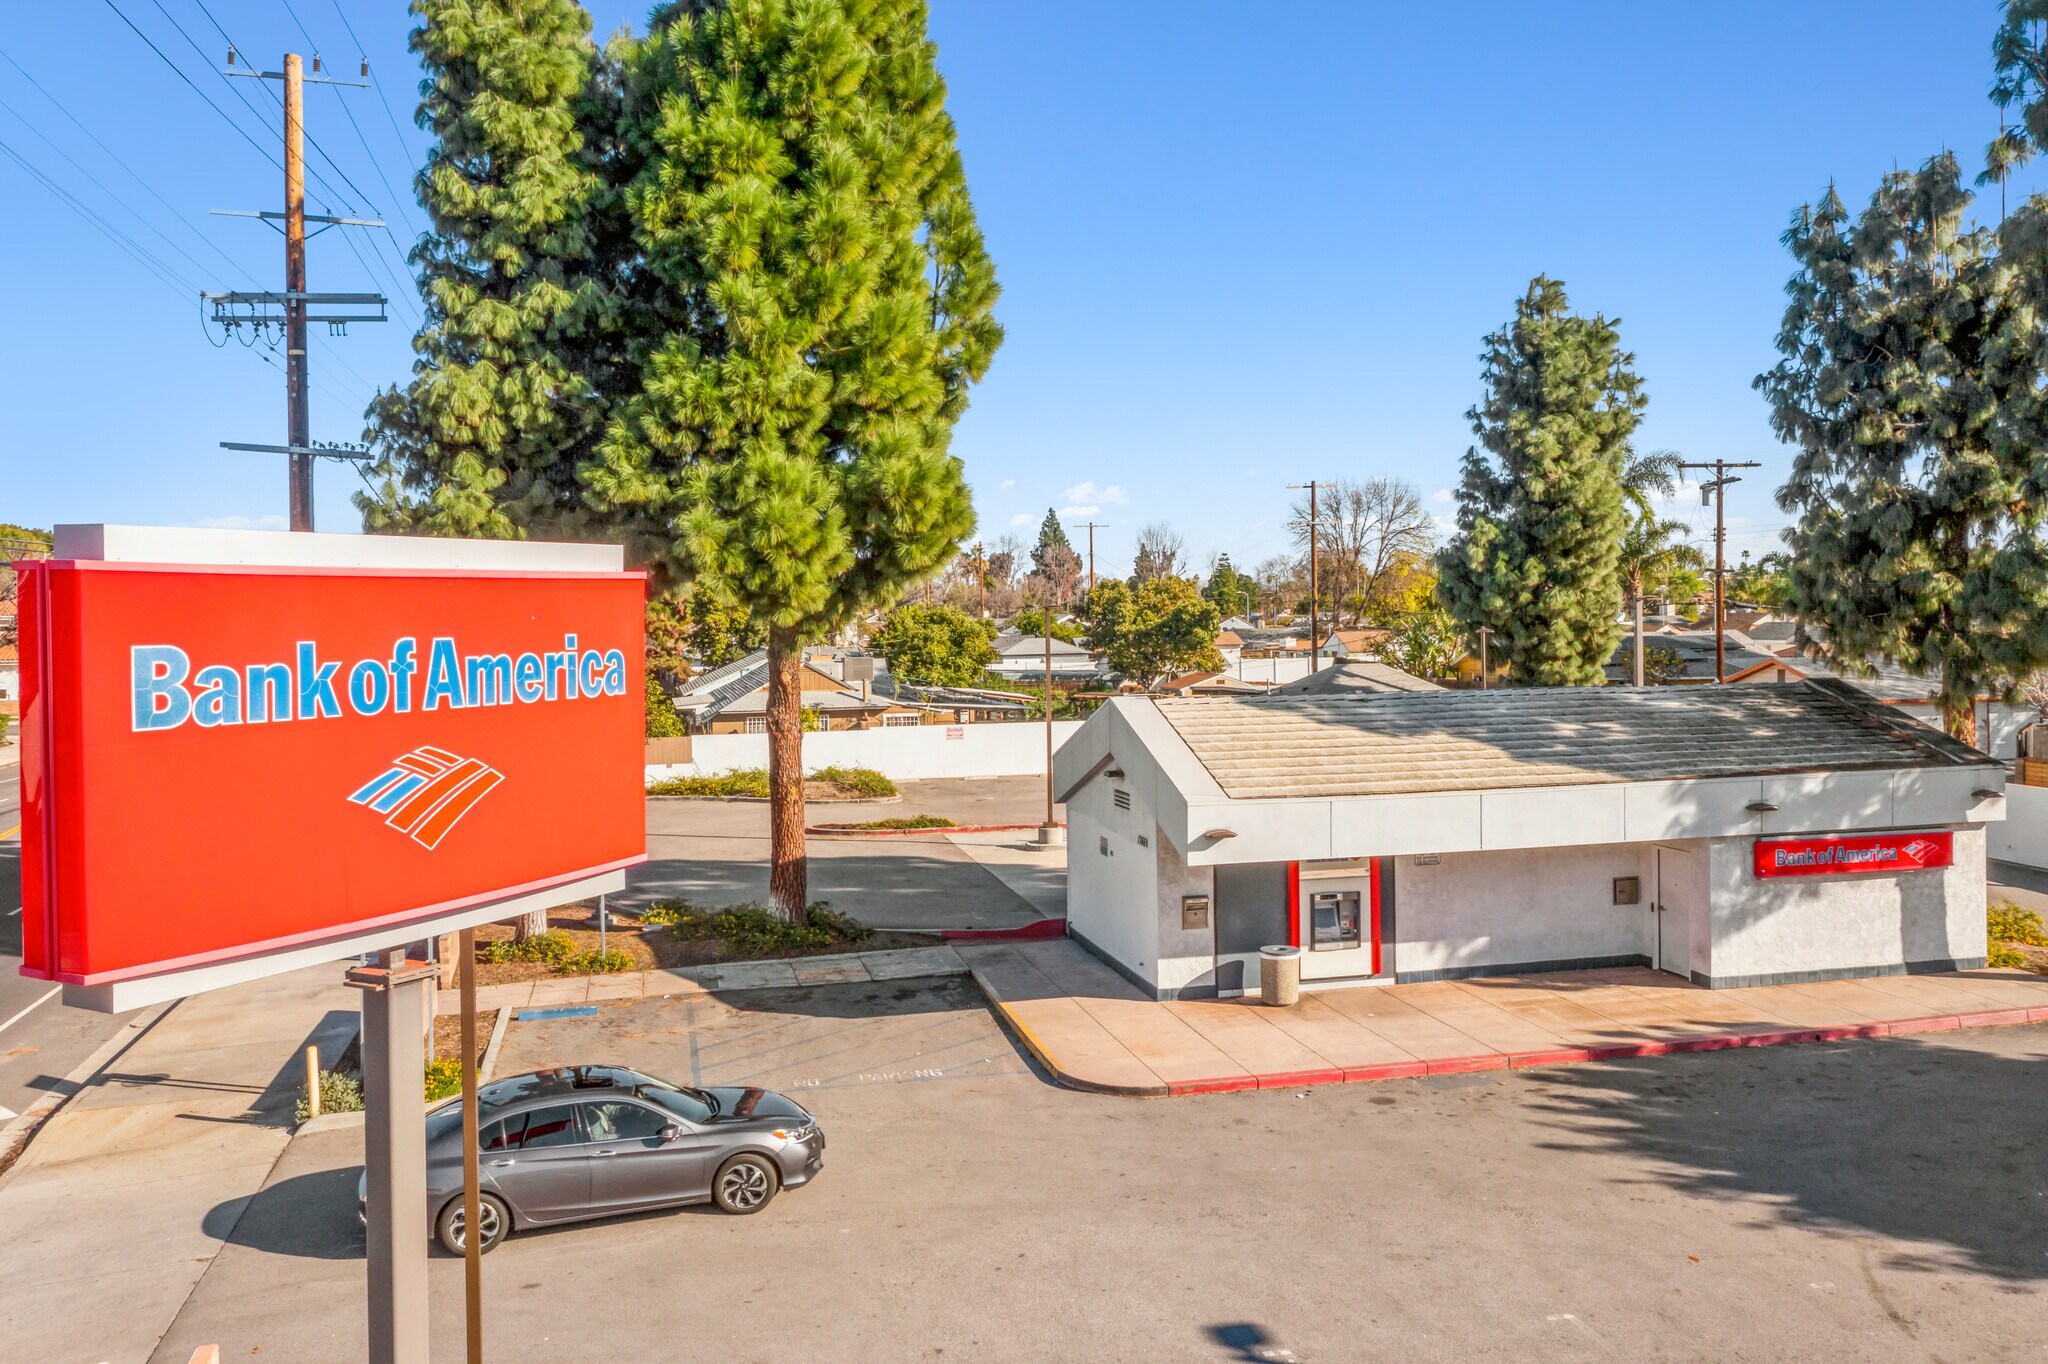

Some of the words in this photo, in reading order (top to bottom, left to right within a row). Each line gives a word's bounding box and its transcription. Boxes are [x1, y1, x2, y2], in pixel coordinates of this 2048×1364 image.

[131, 641, 342, 732] Bank
[348, 637, 417, 714] of
[422, 633, 626, 710] America
[1775, 848, 1816, 867] Bank
[1817, 846, 1834, 865] of
[1836, 844, 1897, 864] America
